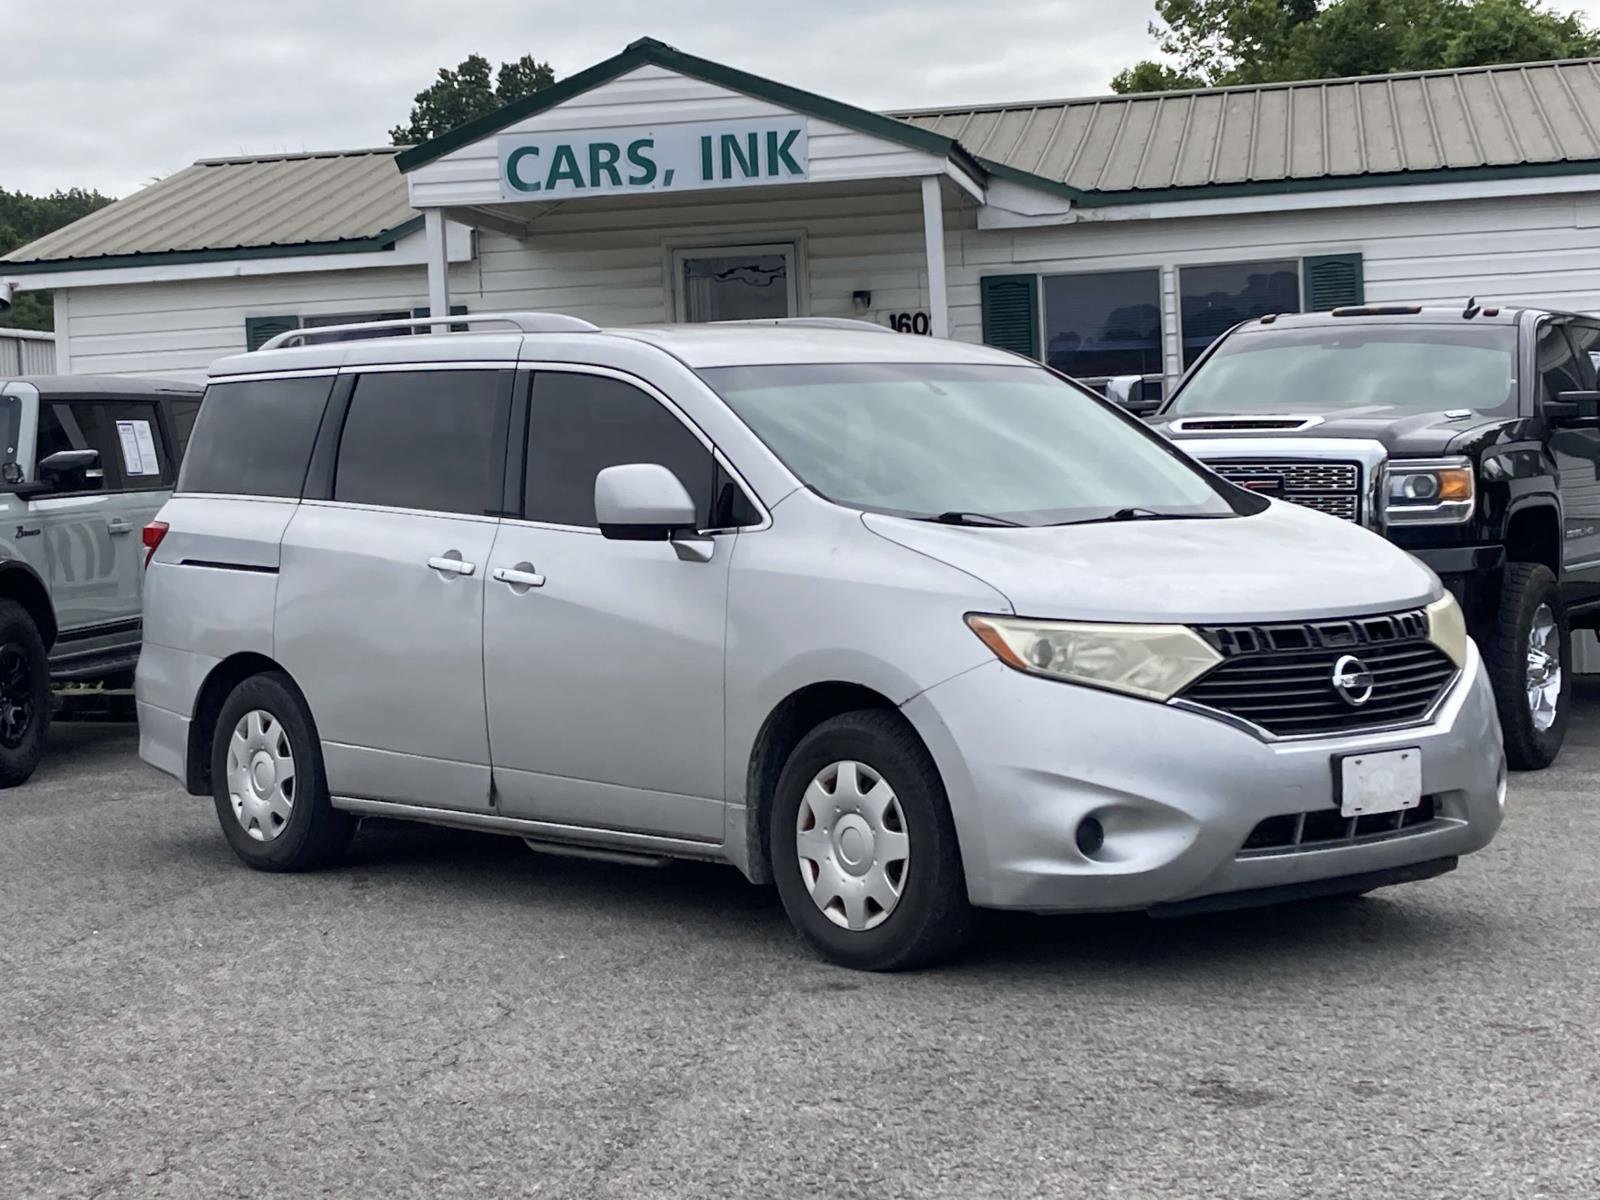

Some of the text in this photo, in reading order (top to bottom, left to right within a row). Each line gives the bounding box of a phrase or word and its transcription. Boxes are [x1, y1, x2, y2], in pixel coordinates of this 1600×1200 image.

[506, 129, 804, 192] CARS, INK
[889, 311, 932, 336] 160
